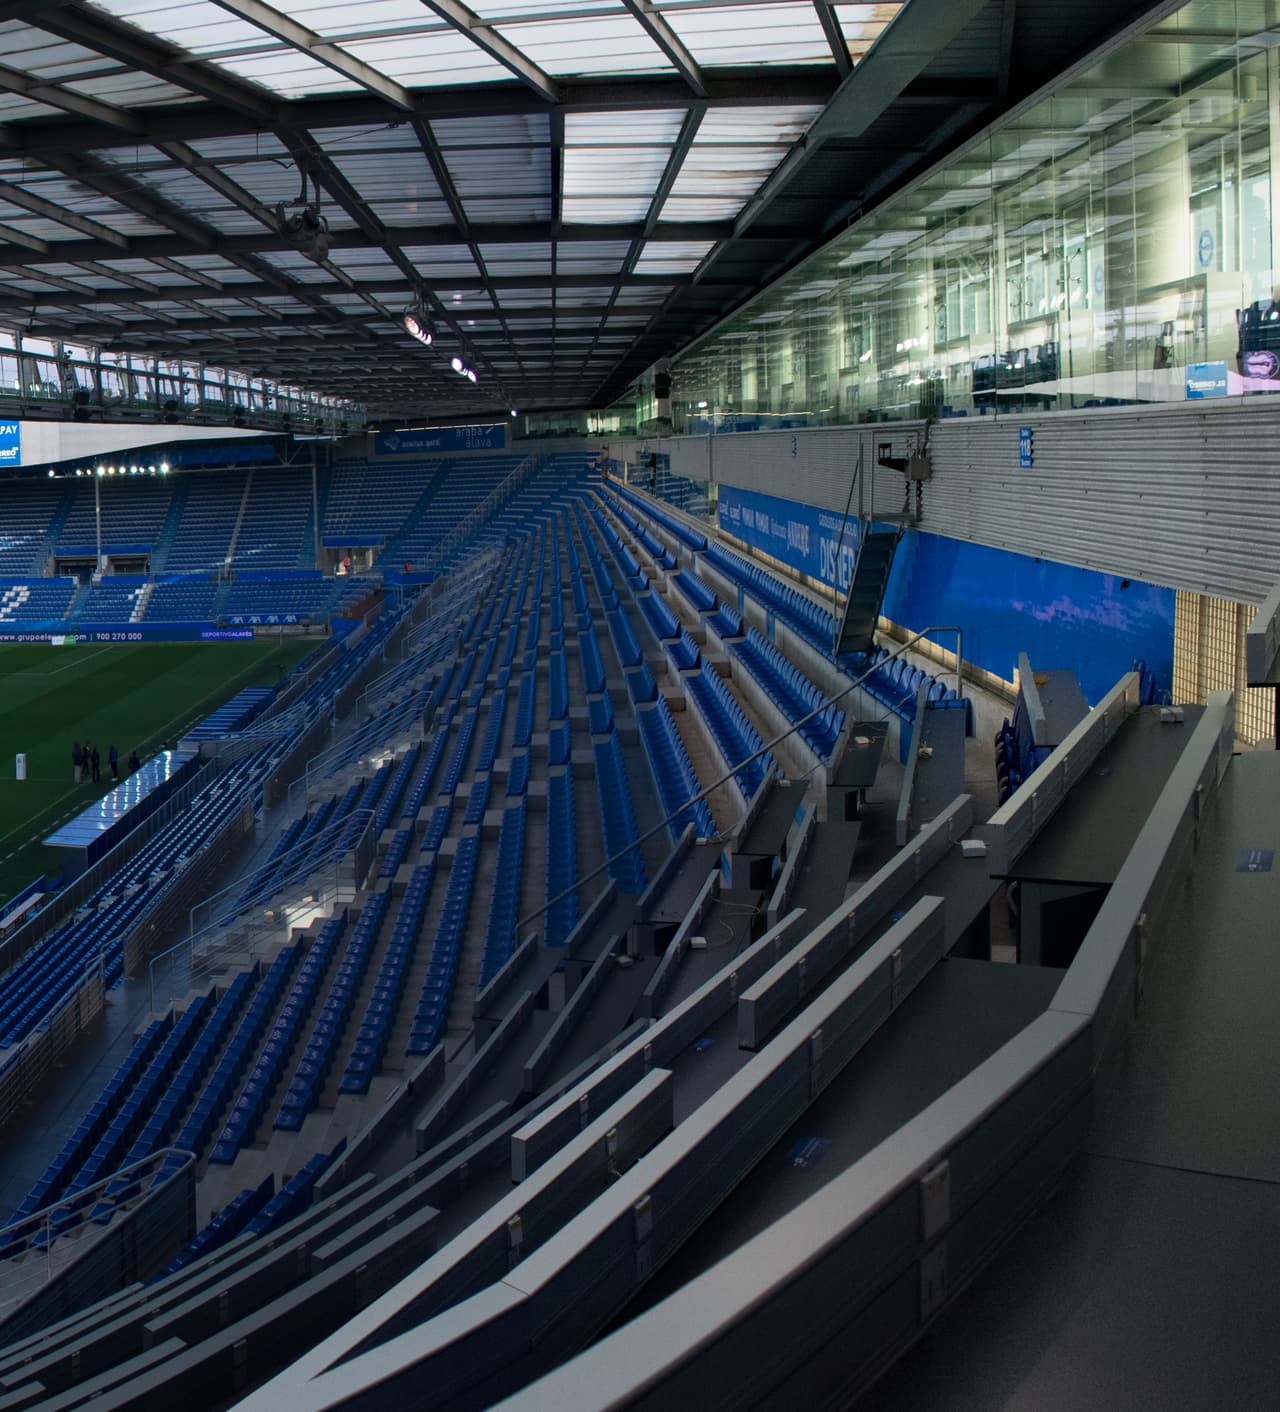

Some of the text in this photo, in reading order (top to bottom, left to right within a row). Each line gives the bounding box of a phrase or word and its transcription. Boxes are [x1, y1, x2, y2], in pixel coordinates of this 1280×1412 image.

[96, 632, 110, 641] 900
[112, 632, 126, 641] 270
[128, 632, 142, 641] 000
